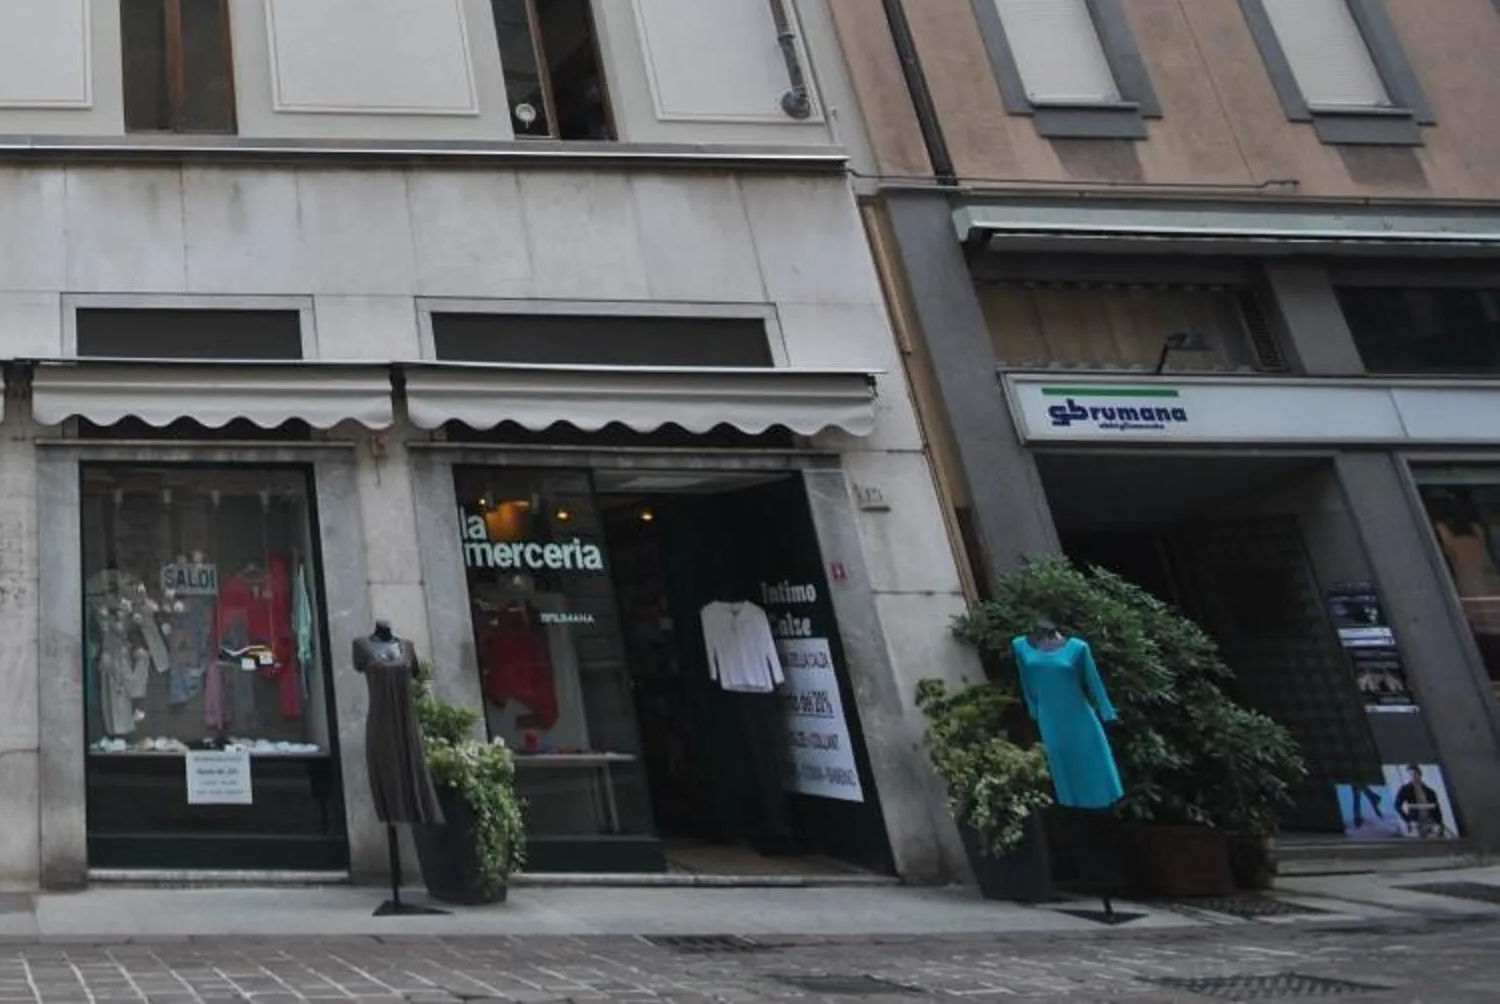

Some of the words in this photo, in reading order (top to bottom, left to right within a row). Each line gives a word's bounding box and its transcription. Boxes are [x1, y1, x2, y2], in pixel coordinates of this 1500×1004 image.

[460, 506, 487, 539] la
[464, 537, 603, 569] merceria
[164, 567, 215, 588] SALDI
[761, 579, 817, 604] Intimo
